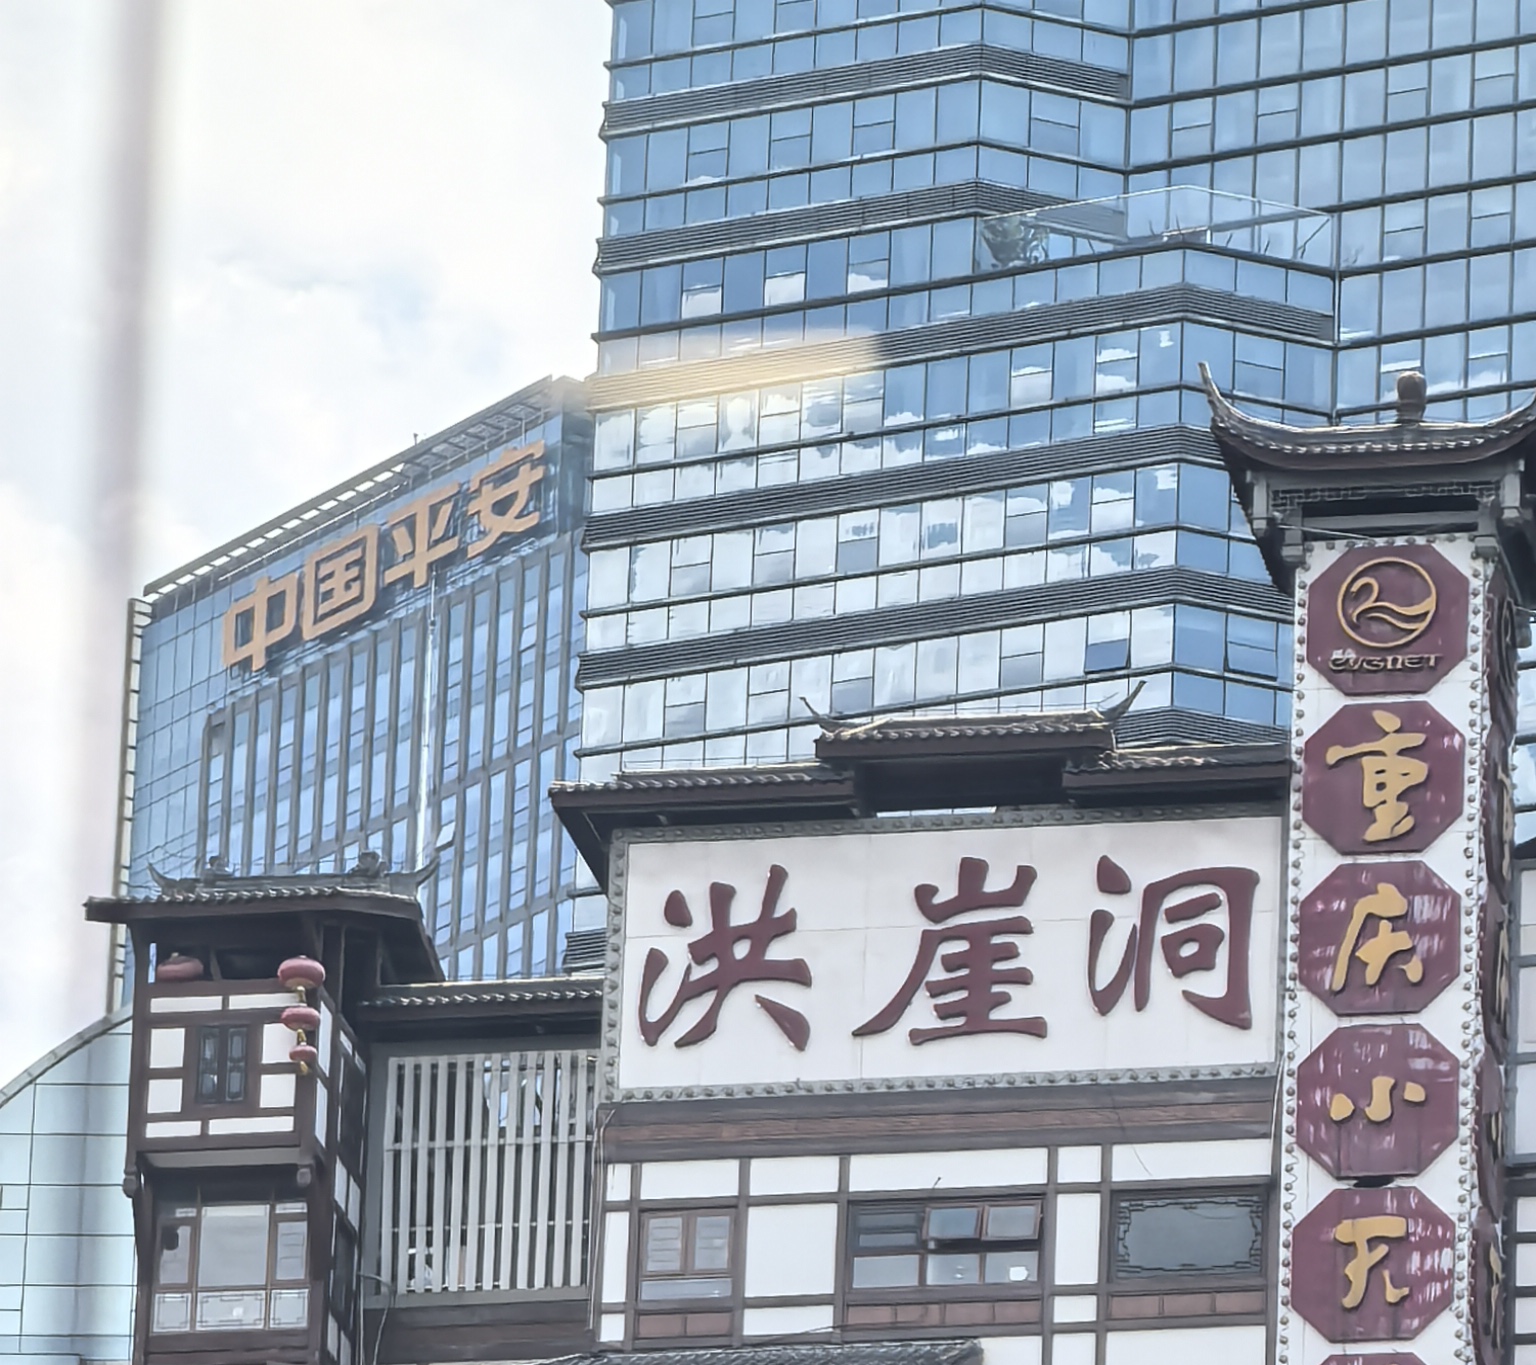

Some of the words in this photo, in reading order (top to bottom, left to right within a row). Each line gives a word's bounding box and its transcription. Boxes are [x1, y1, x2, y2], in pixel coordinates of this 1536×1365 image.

[222, 440, 546, 672] 中国平安
[637, 854, 1260, 1050] 洪崖洞
